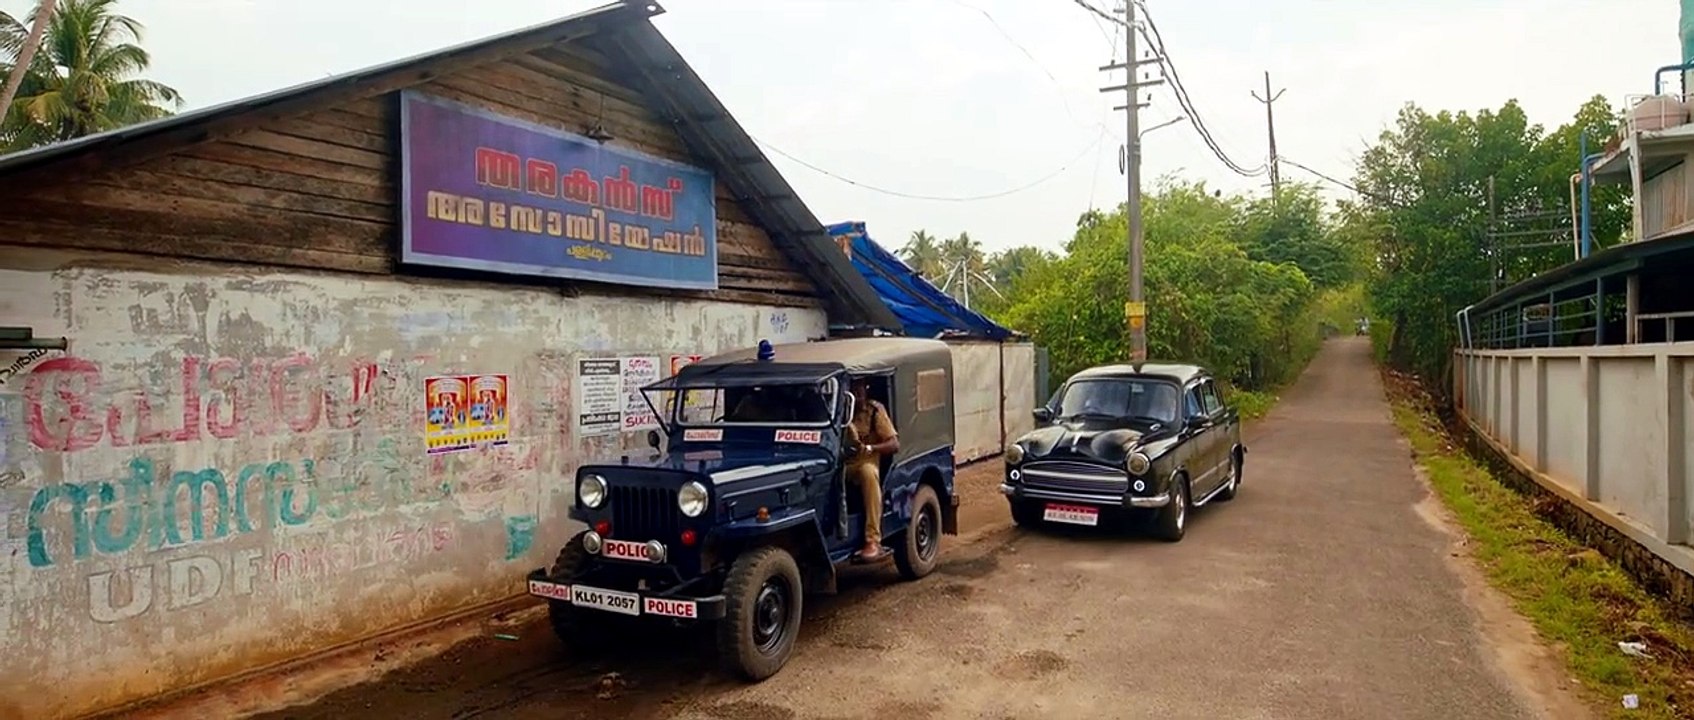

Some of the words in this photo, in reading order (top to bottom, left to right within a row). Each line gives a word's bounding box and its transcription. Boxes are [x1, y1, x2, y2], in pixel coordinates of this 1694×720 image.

[475, 146, 684, 220] തരകൻസ്
[426, 190, 706, 256] അസോസിയേഷൻ
[777, 432, 818, 442] POLICE
[607, 542, 649, 558] POLIC
[87, 550, 263, 624] UDF
[575, 590, 603, 605] KL01
[607, 595, 635, 610] 2057
[648, 600, 694, 616] POLICE
